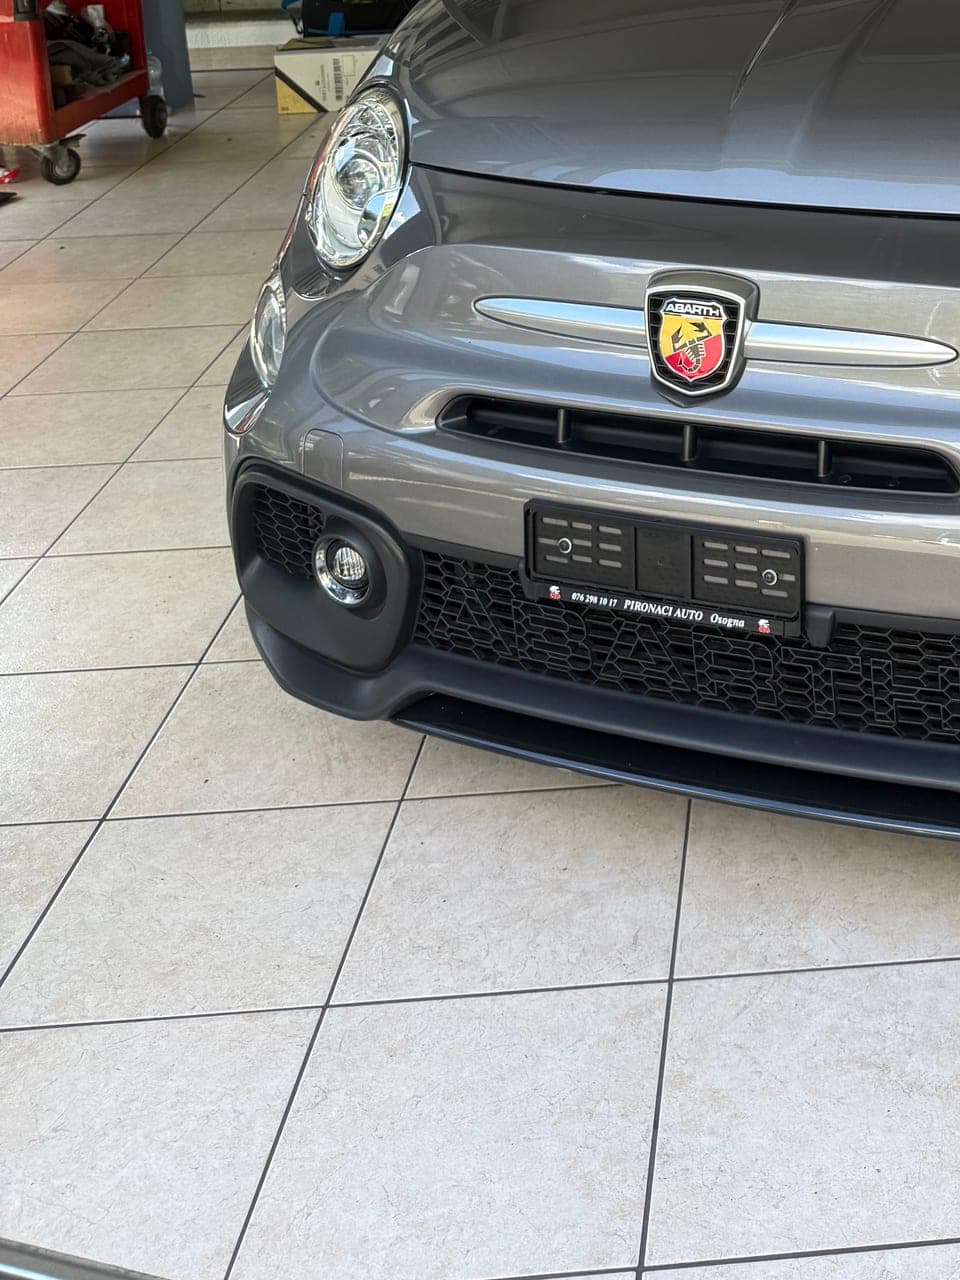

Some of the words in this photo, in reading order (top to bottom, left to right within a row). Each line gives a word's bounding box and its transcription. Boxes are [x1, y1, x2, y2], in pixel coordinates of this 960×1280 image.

[666, 303, 719, 316] ABARTH
[571, 592, 584, 601] 076
[585, 594, 597, 604] 298
[608, 598, 618, 607] 17
[623, 599, 673, 617] PIRONACI
[674, 607, 703, 621] AUTO
[710, 613, 745, 628] Osogna
